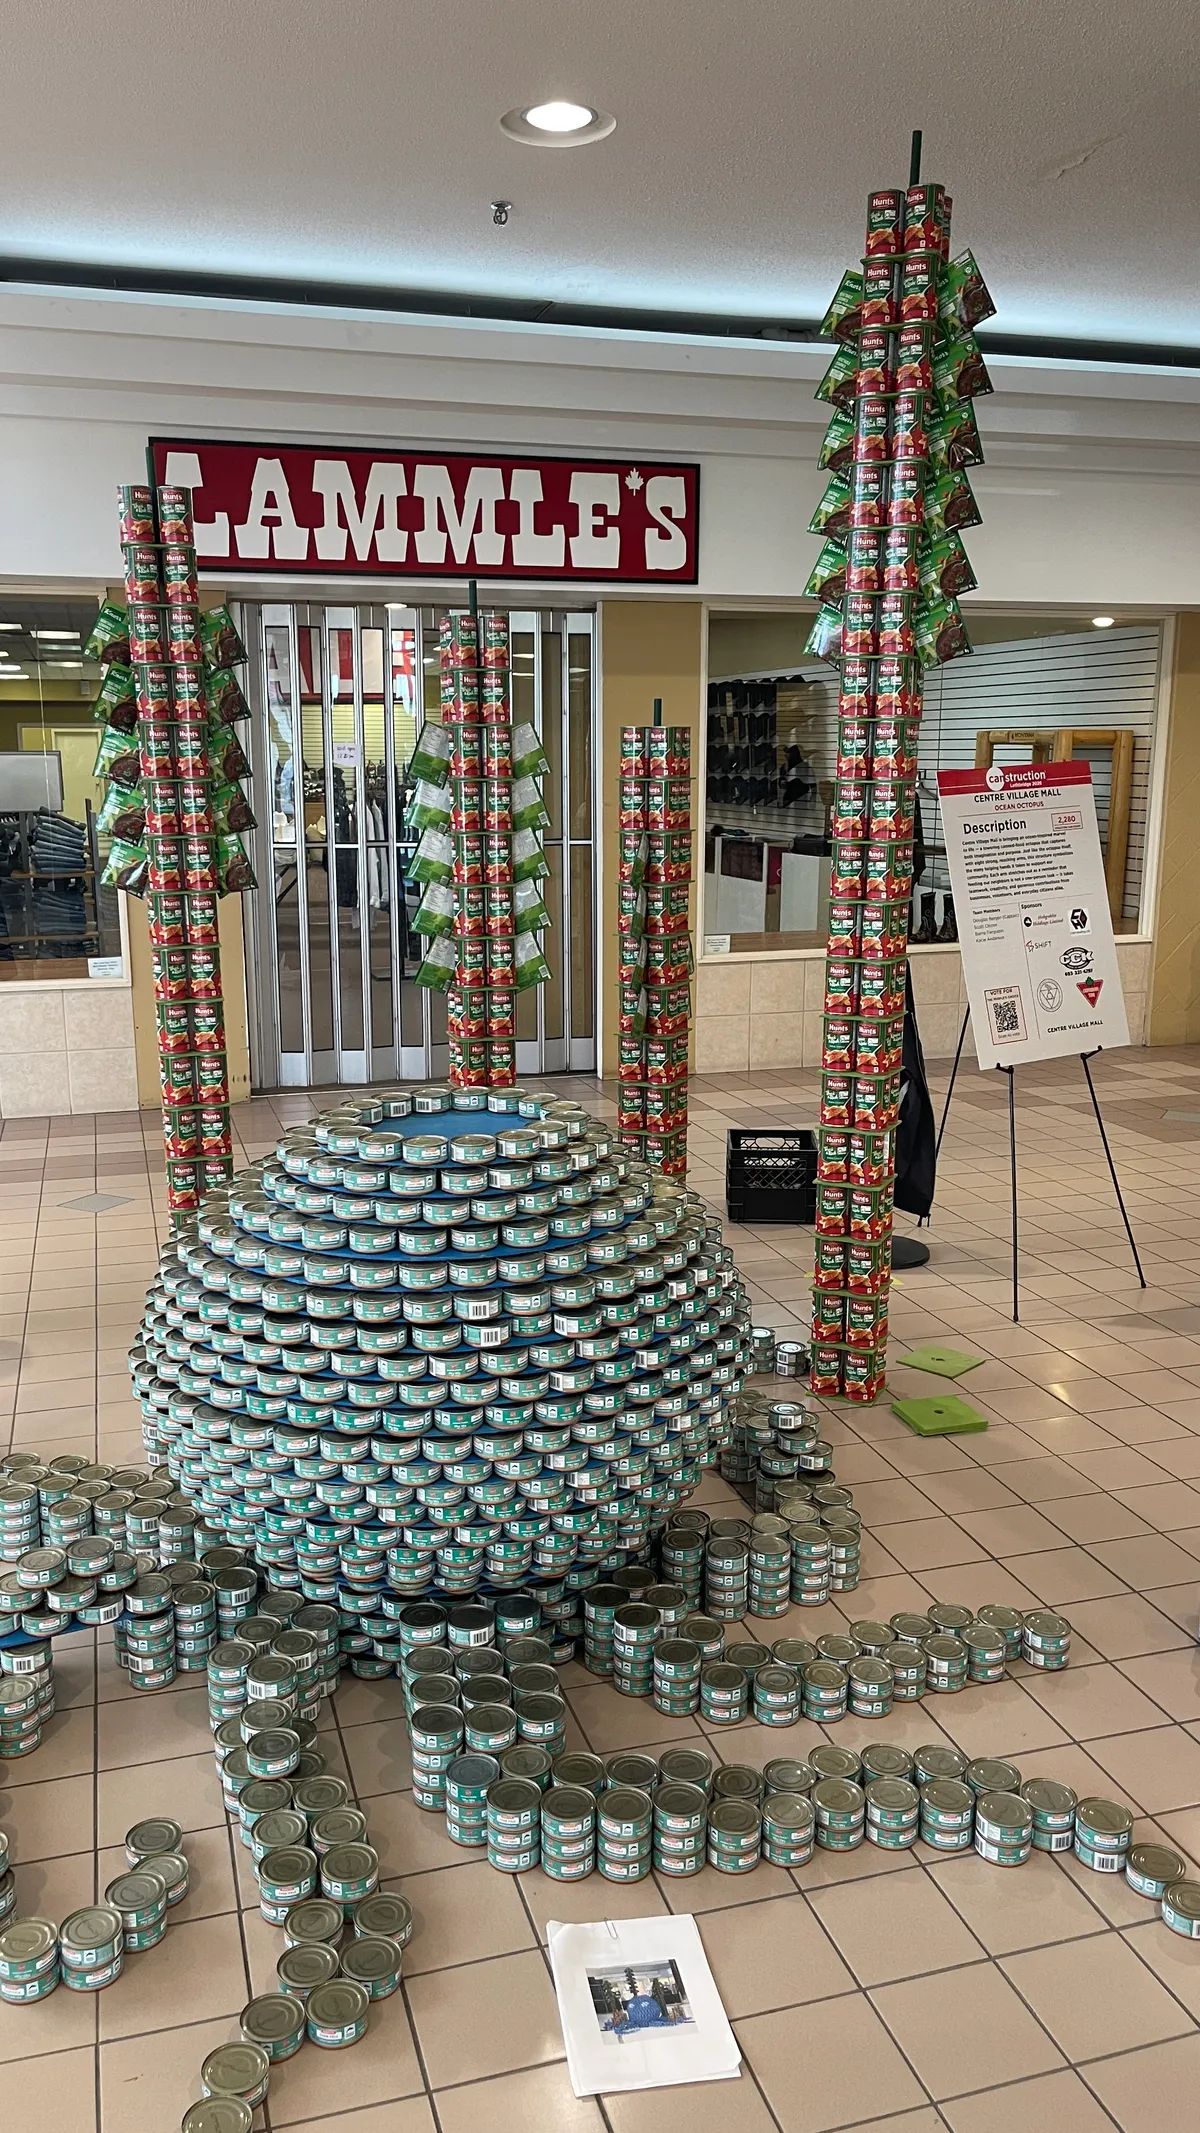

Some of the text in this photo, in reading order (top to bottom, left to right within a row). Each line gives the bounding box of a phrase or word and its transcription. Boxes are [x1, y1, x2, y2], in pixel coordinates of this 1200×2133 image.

[163, 451, 687, 571] LAMMLE'S
[988, 771, 1046, 783] canstruction
[974, 788, 1061, 803] CENTRE VILLAGE MALL
[995, 801, 1044, 811] OCEAN OCTOPUS
[963, 819, 1026, 834] Description
[1035, 941, 1052, 949] SHIFT
[1068, 1022, 1089, 1030] VILLAGE
